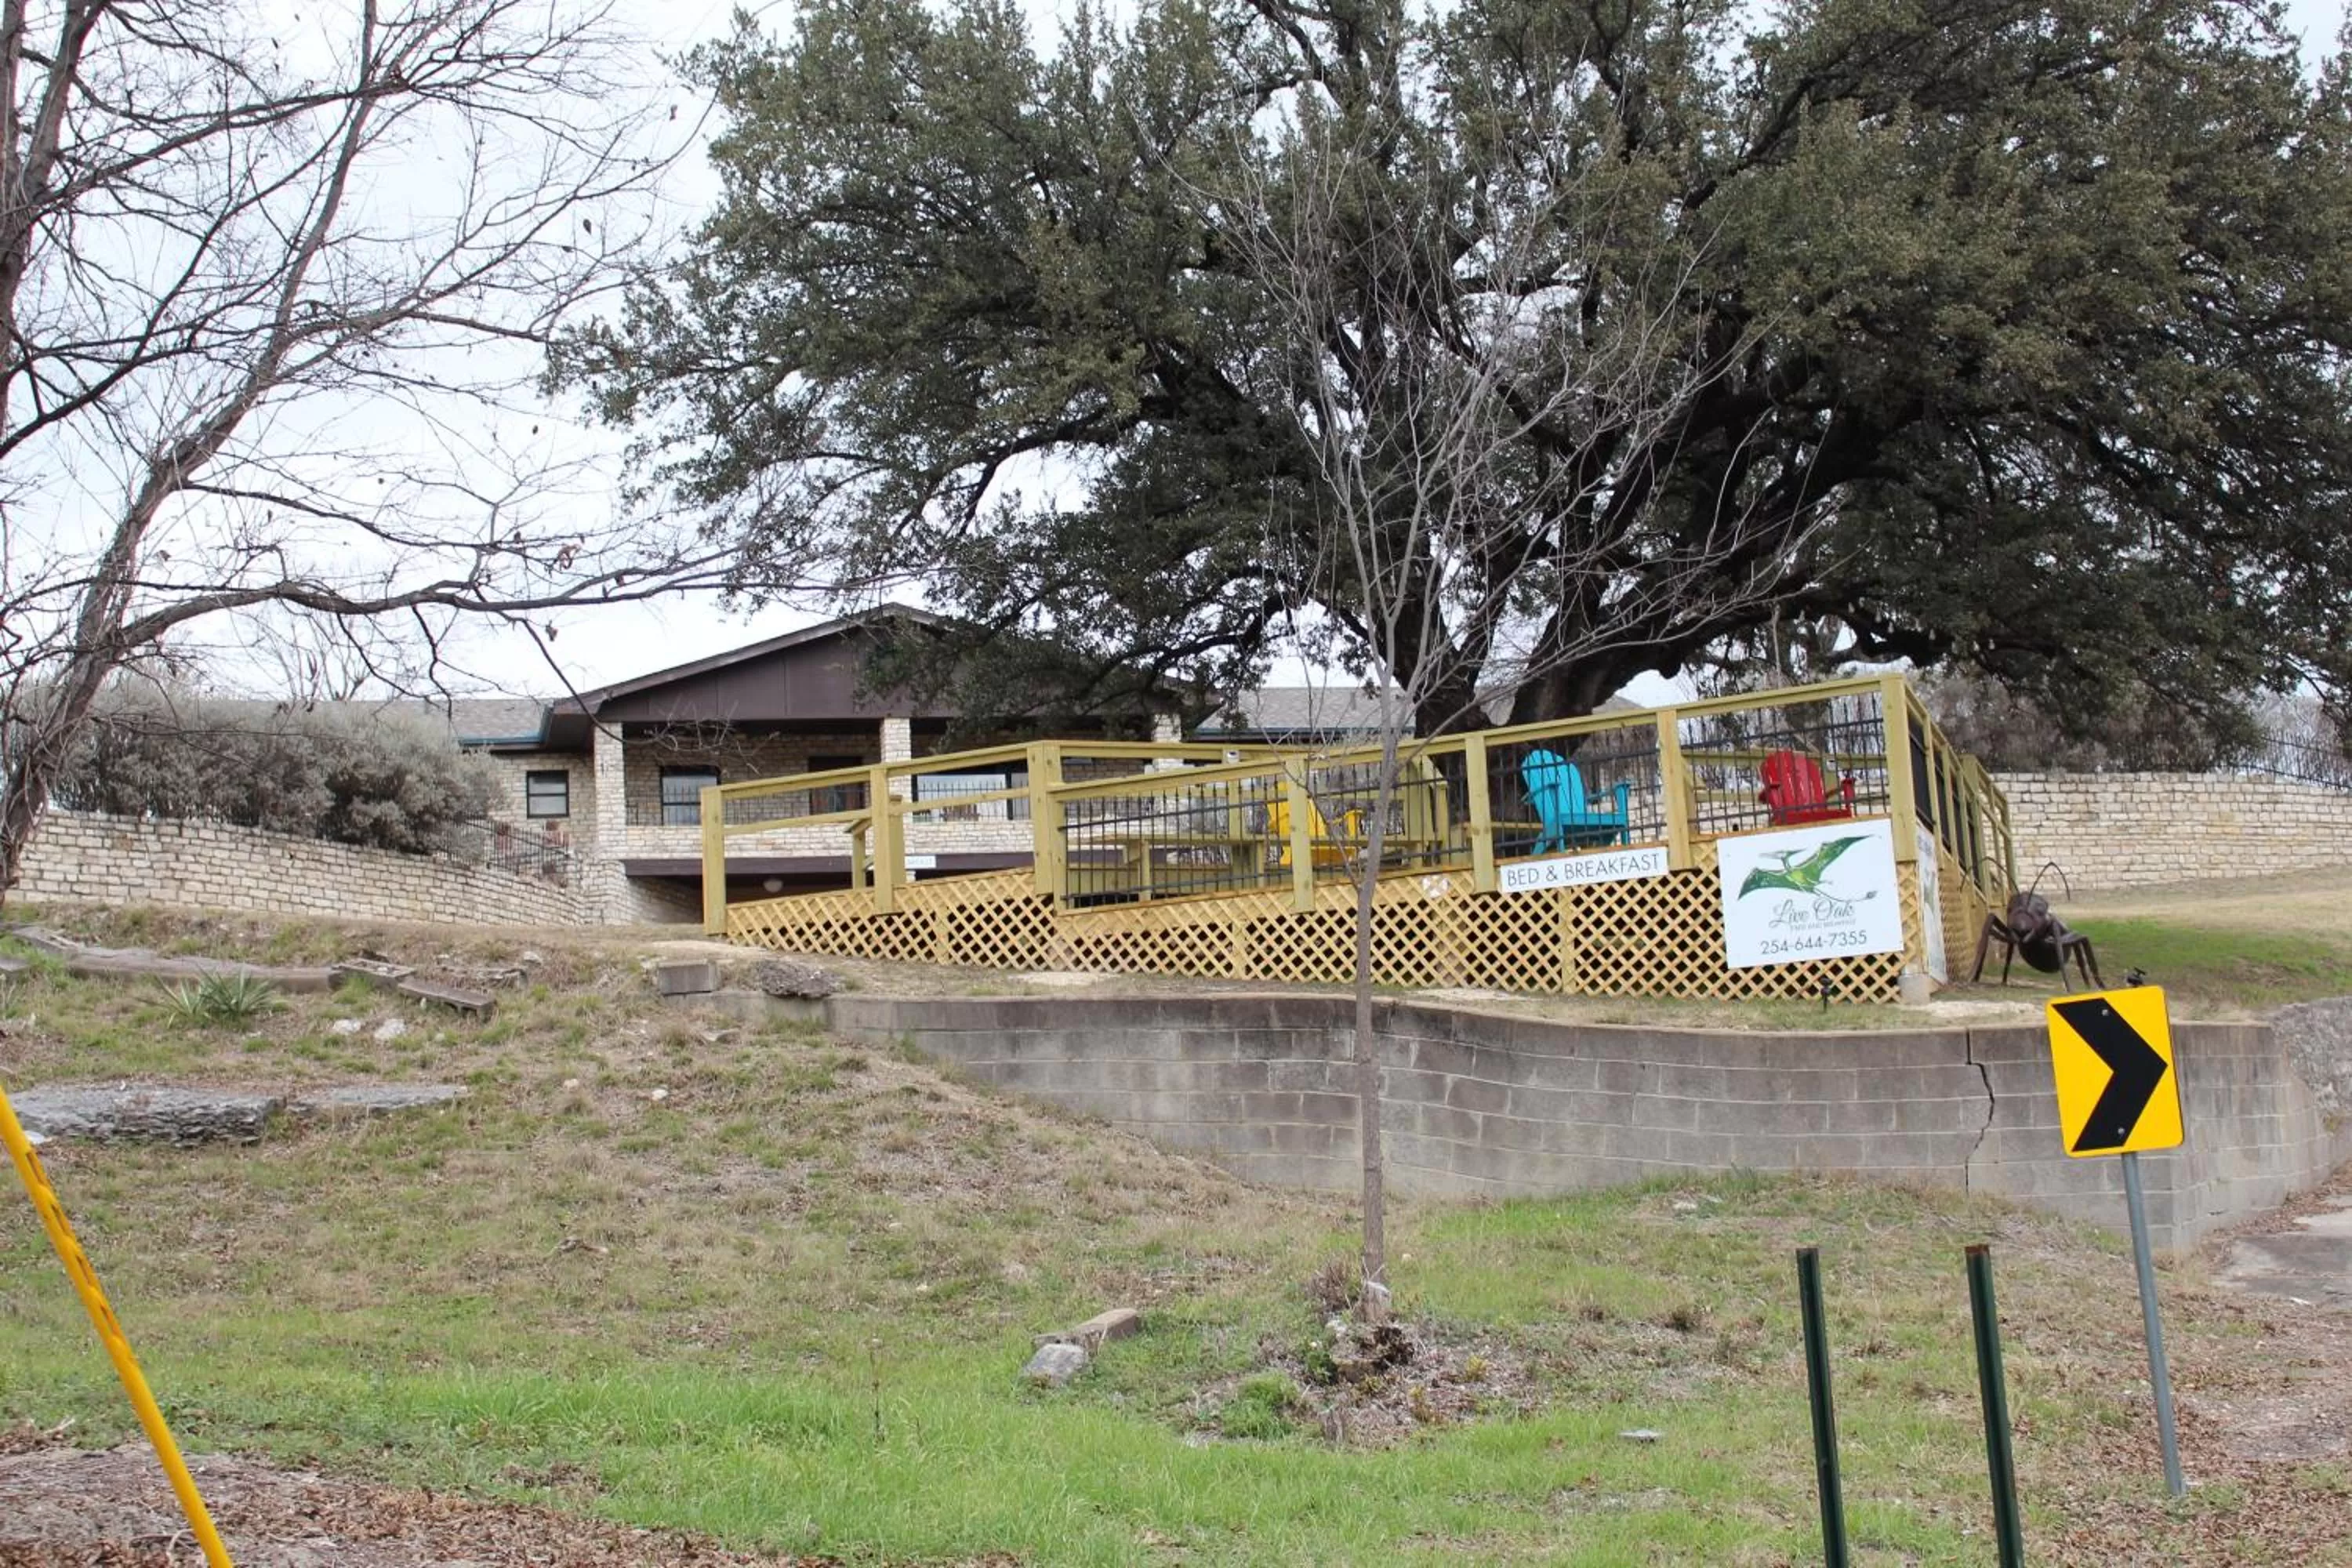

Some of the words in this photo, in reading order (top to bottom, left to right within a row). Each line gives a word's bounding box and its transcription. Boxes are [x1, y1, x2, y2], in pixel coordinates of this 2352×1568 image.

[1507, 868, 1539, 887] BED
[1545, 865, 1558, 882] &
[1564, 853, 1660, 880] BREAKFAST
[1768, 898, 1809, 929] Live
[1813, 898, 1854, 921] Oak
[1759, 930, 1867, 955] 254-644-7355
